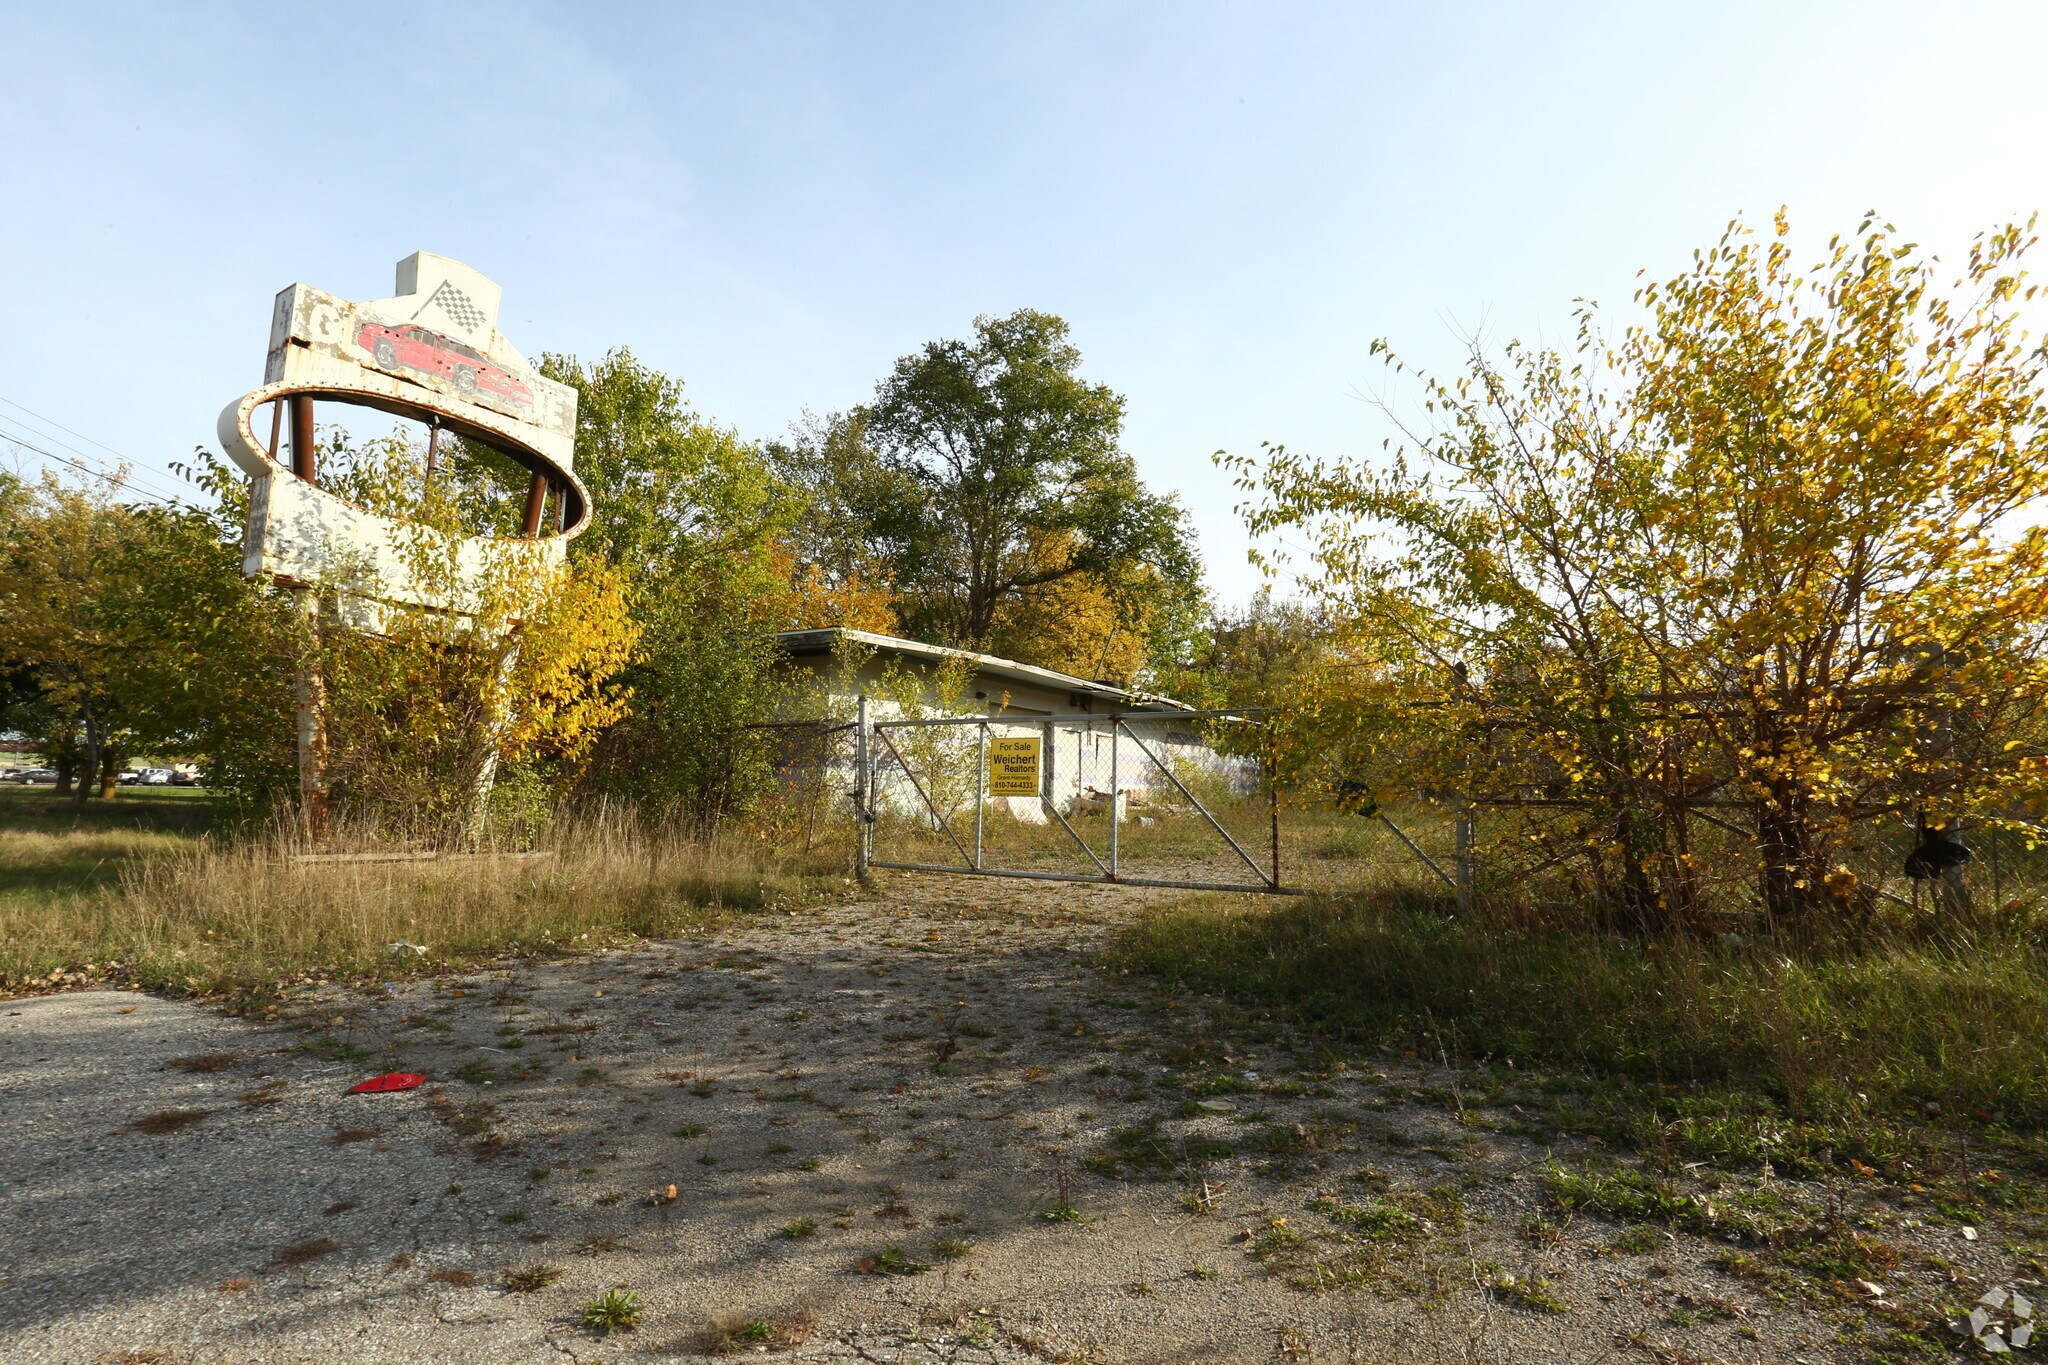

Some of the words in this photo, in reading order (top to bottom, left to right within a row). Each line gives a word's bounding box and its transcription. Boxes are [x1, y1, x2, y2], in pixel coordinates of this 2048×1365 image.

[1000, 742, 1012, 751] For
[1014, 742, 1031, 751] Sale
[993, 754, 1036, 764] Weichert
[1004, 764, 1035, 773] Realtors
